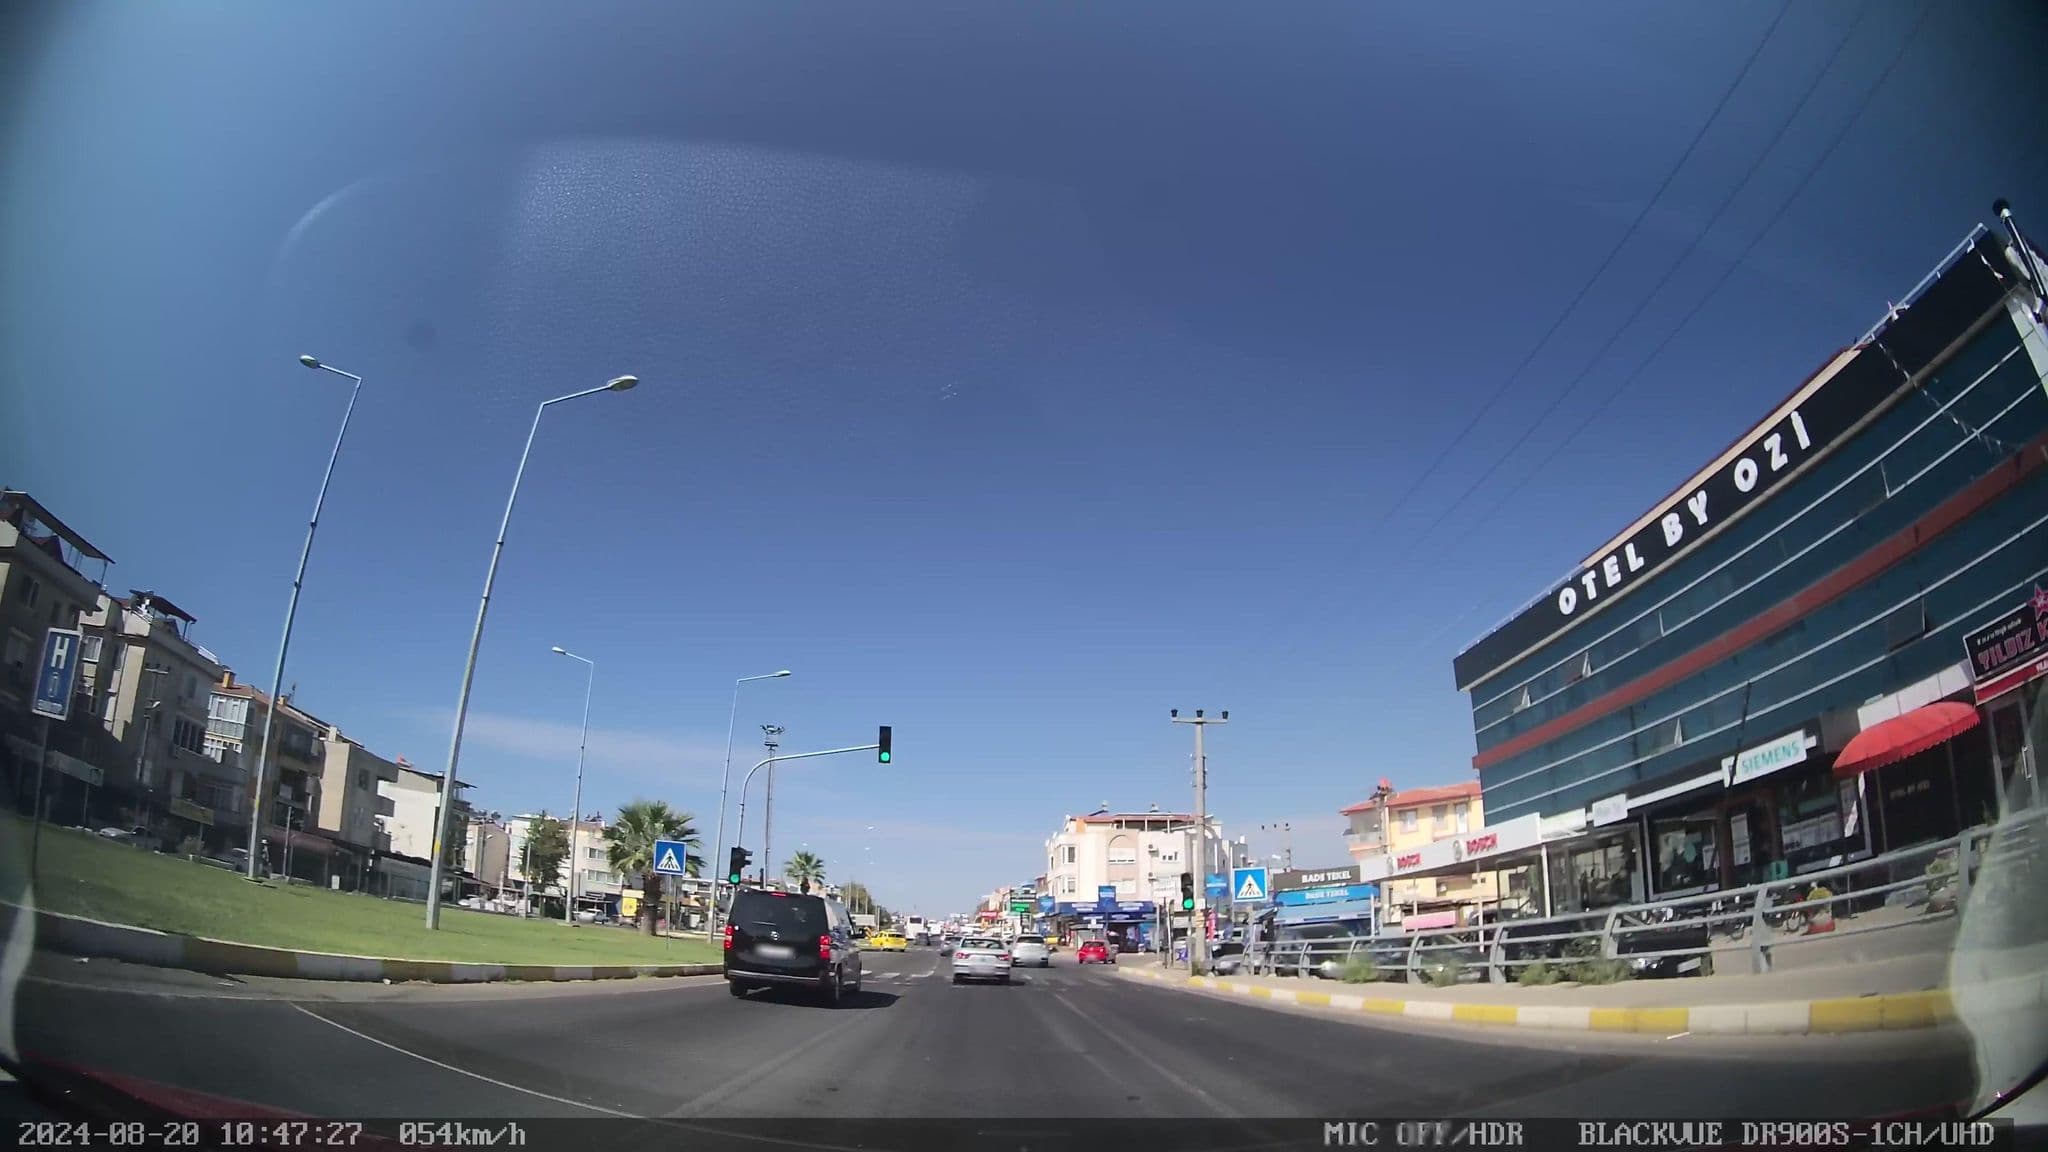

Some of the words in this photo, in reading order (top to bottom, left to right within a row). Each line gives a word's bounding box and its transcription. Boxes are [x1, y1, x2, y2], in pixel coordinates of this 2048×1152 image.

[1558, 542, 1645, 616] OTEL
[1661, 489, 1708, 547] BY
[51, 636, 70, 669] H
[1742, 740, 1800, 774] SIEMENS
